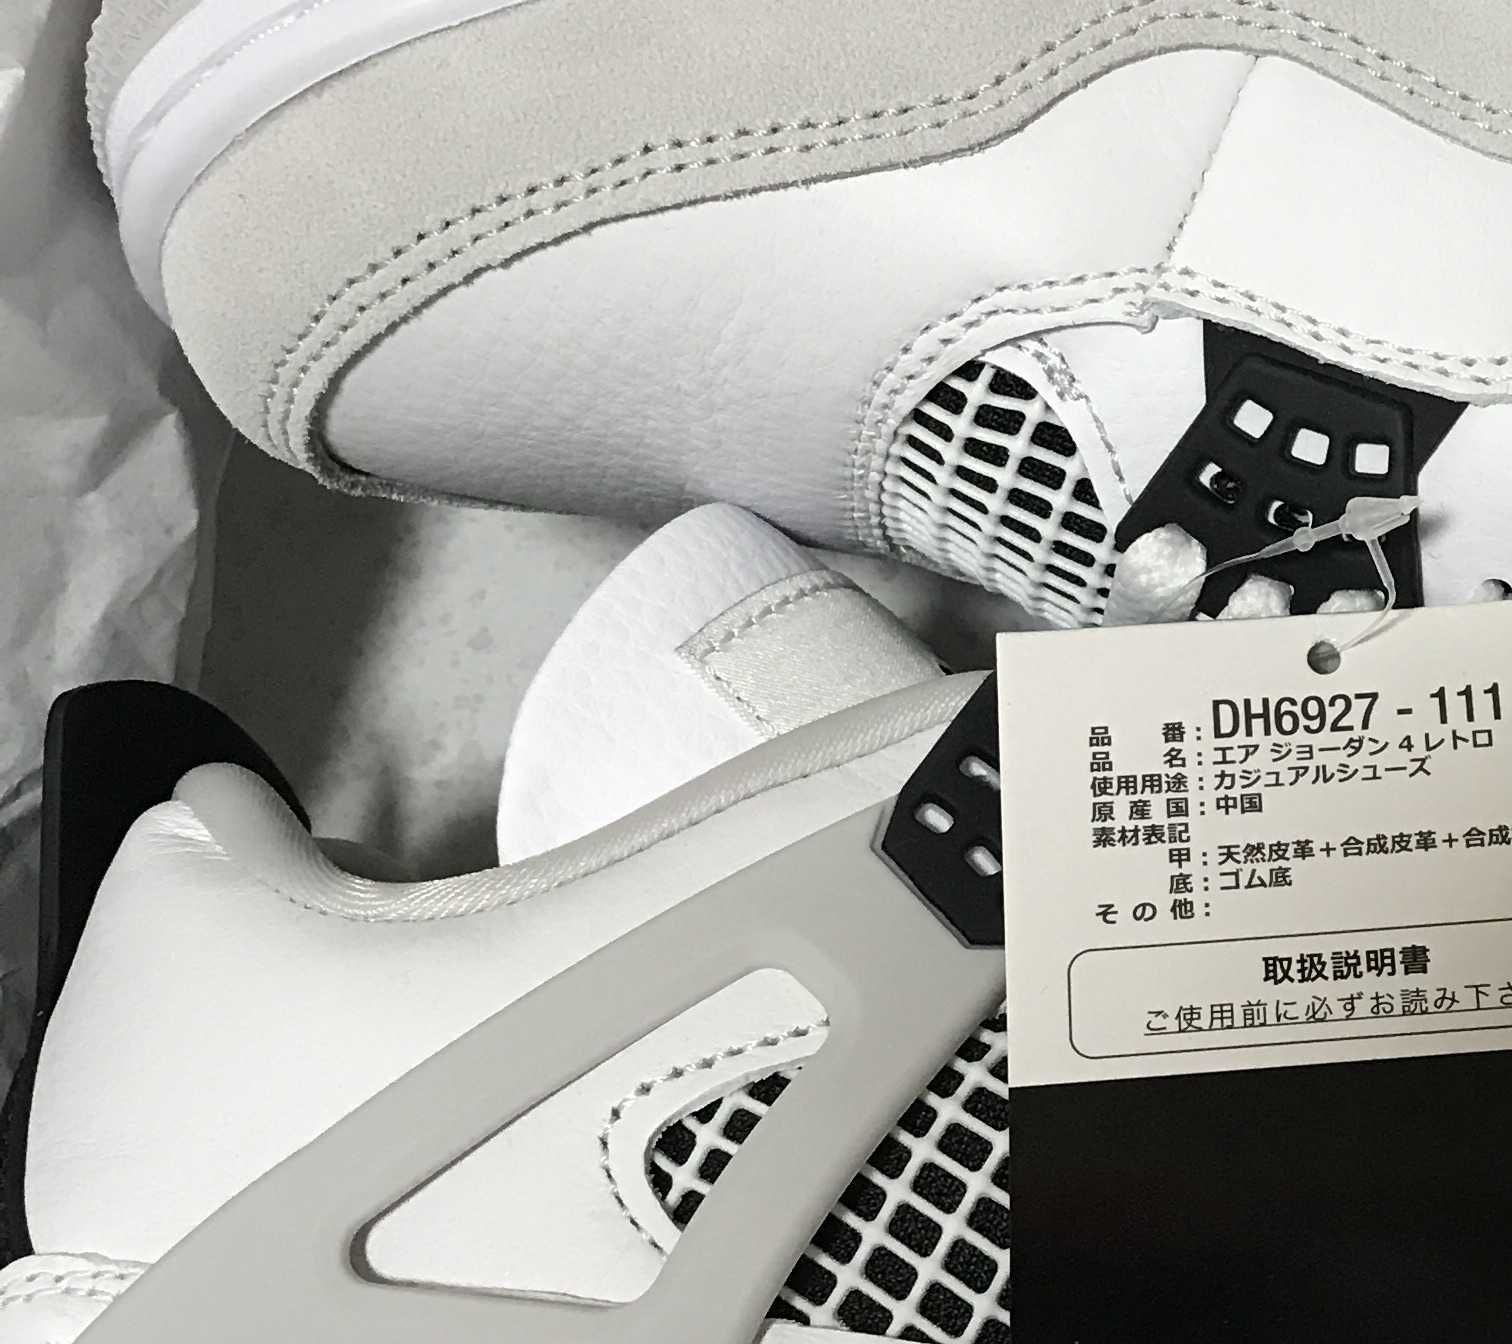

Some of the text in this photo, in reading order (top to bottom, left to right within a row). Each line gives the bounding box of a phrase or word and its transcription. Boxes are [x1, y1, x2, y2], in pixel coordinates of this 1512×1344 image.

[1213, 756, 1431, 791] カジュアルシューズ
[1215, 792, 1263, 815] 中国
[1092, 822, 1190, 848] 素材表記
[1219, 866, 1292, 891] ゴム底
[1262, 944, 1431, 985] 取扱説明書
